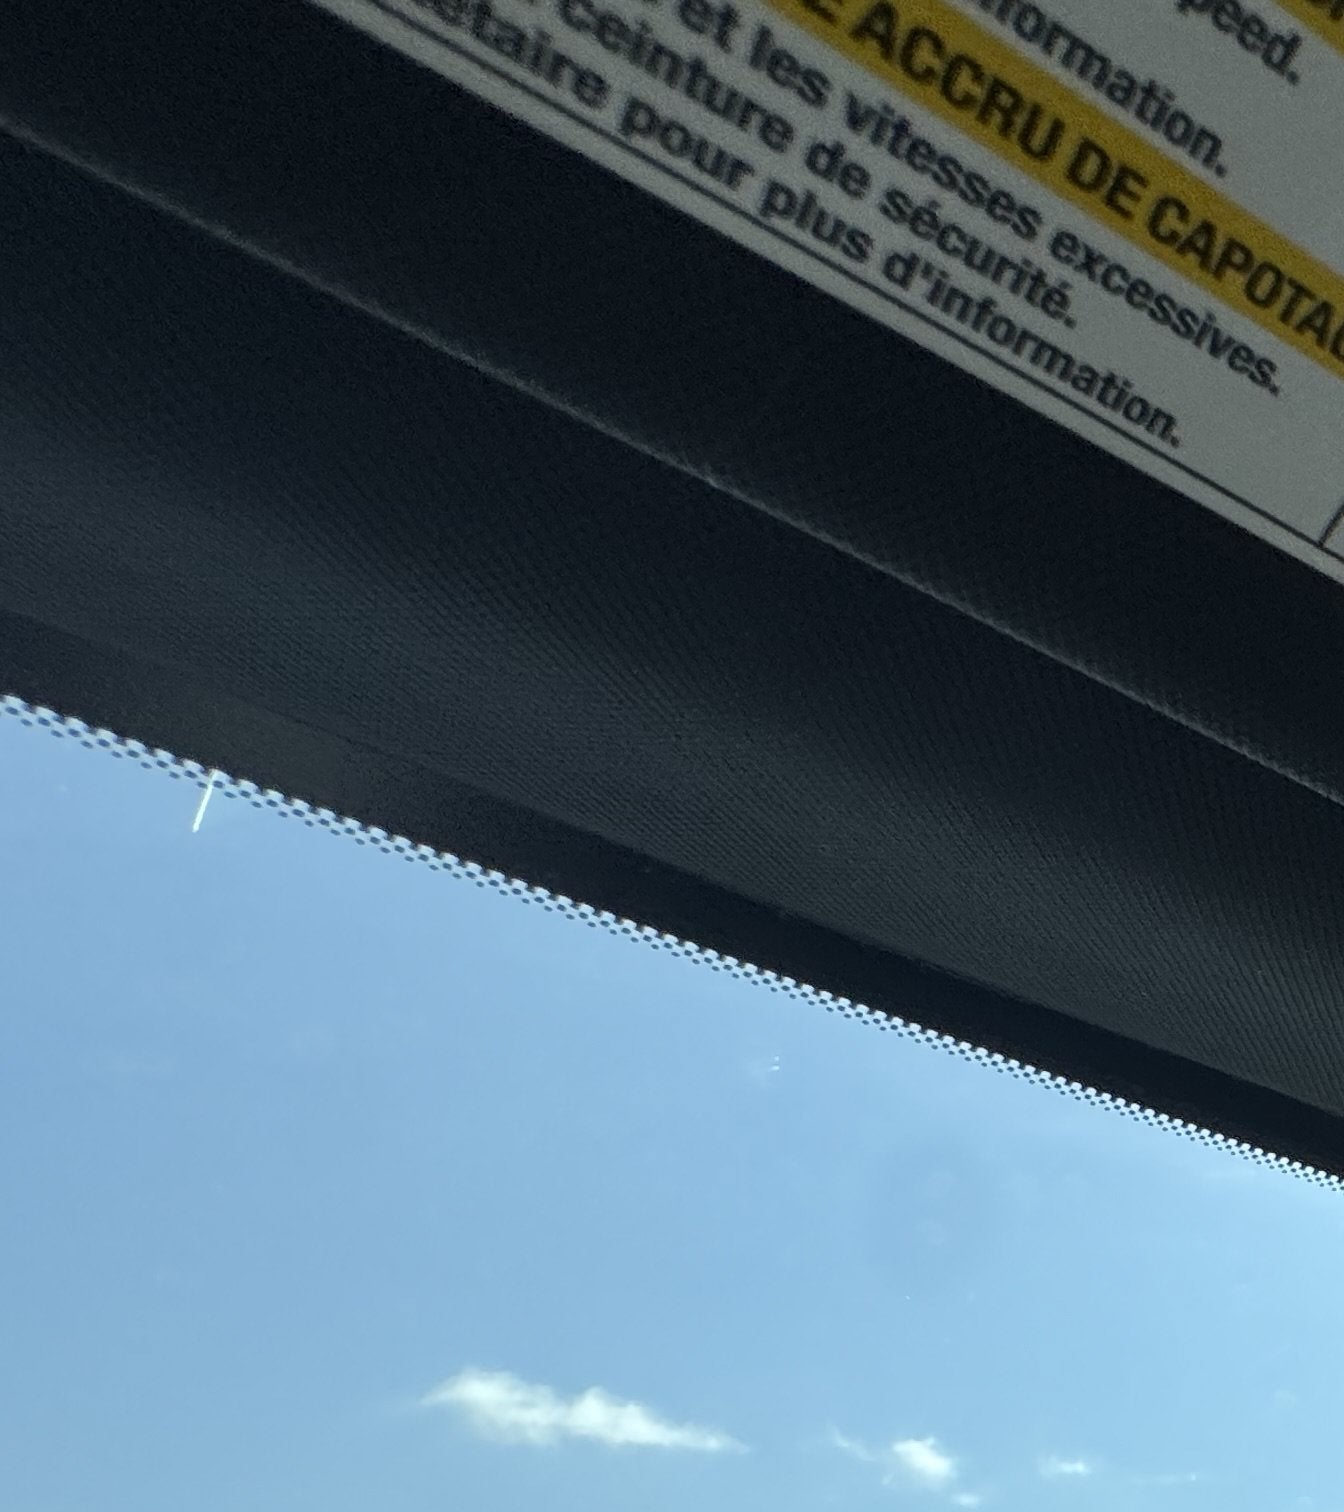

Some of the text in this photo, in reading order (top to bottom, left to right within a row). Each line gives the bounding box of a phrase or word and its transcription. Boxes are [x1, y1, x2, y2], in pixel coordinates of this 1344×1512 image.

[557, 0, 1077, 329] ceinture de sécurité.
[849, 1, 1065, 163] ACCRU
[1064, 135, 1148, 220] DE
[977, 0, 1228, 177] ormation.
[1175, 0, 1300, 86] eed.
[618, 93, 753, 190] pour
[757, 172, 875, 262] plus
[881, 245, 1183, 449] d'information.
[678, 0, 1281, 397] et les vitesses excessives.
